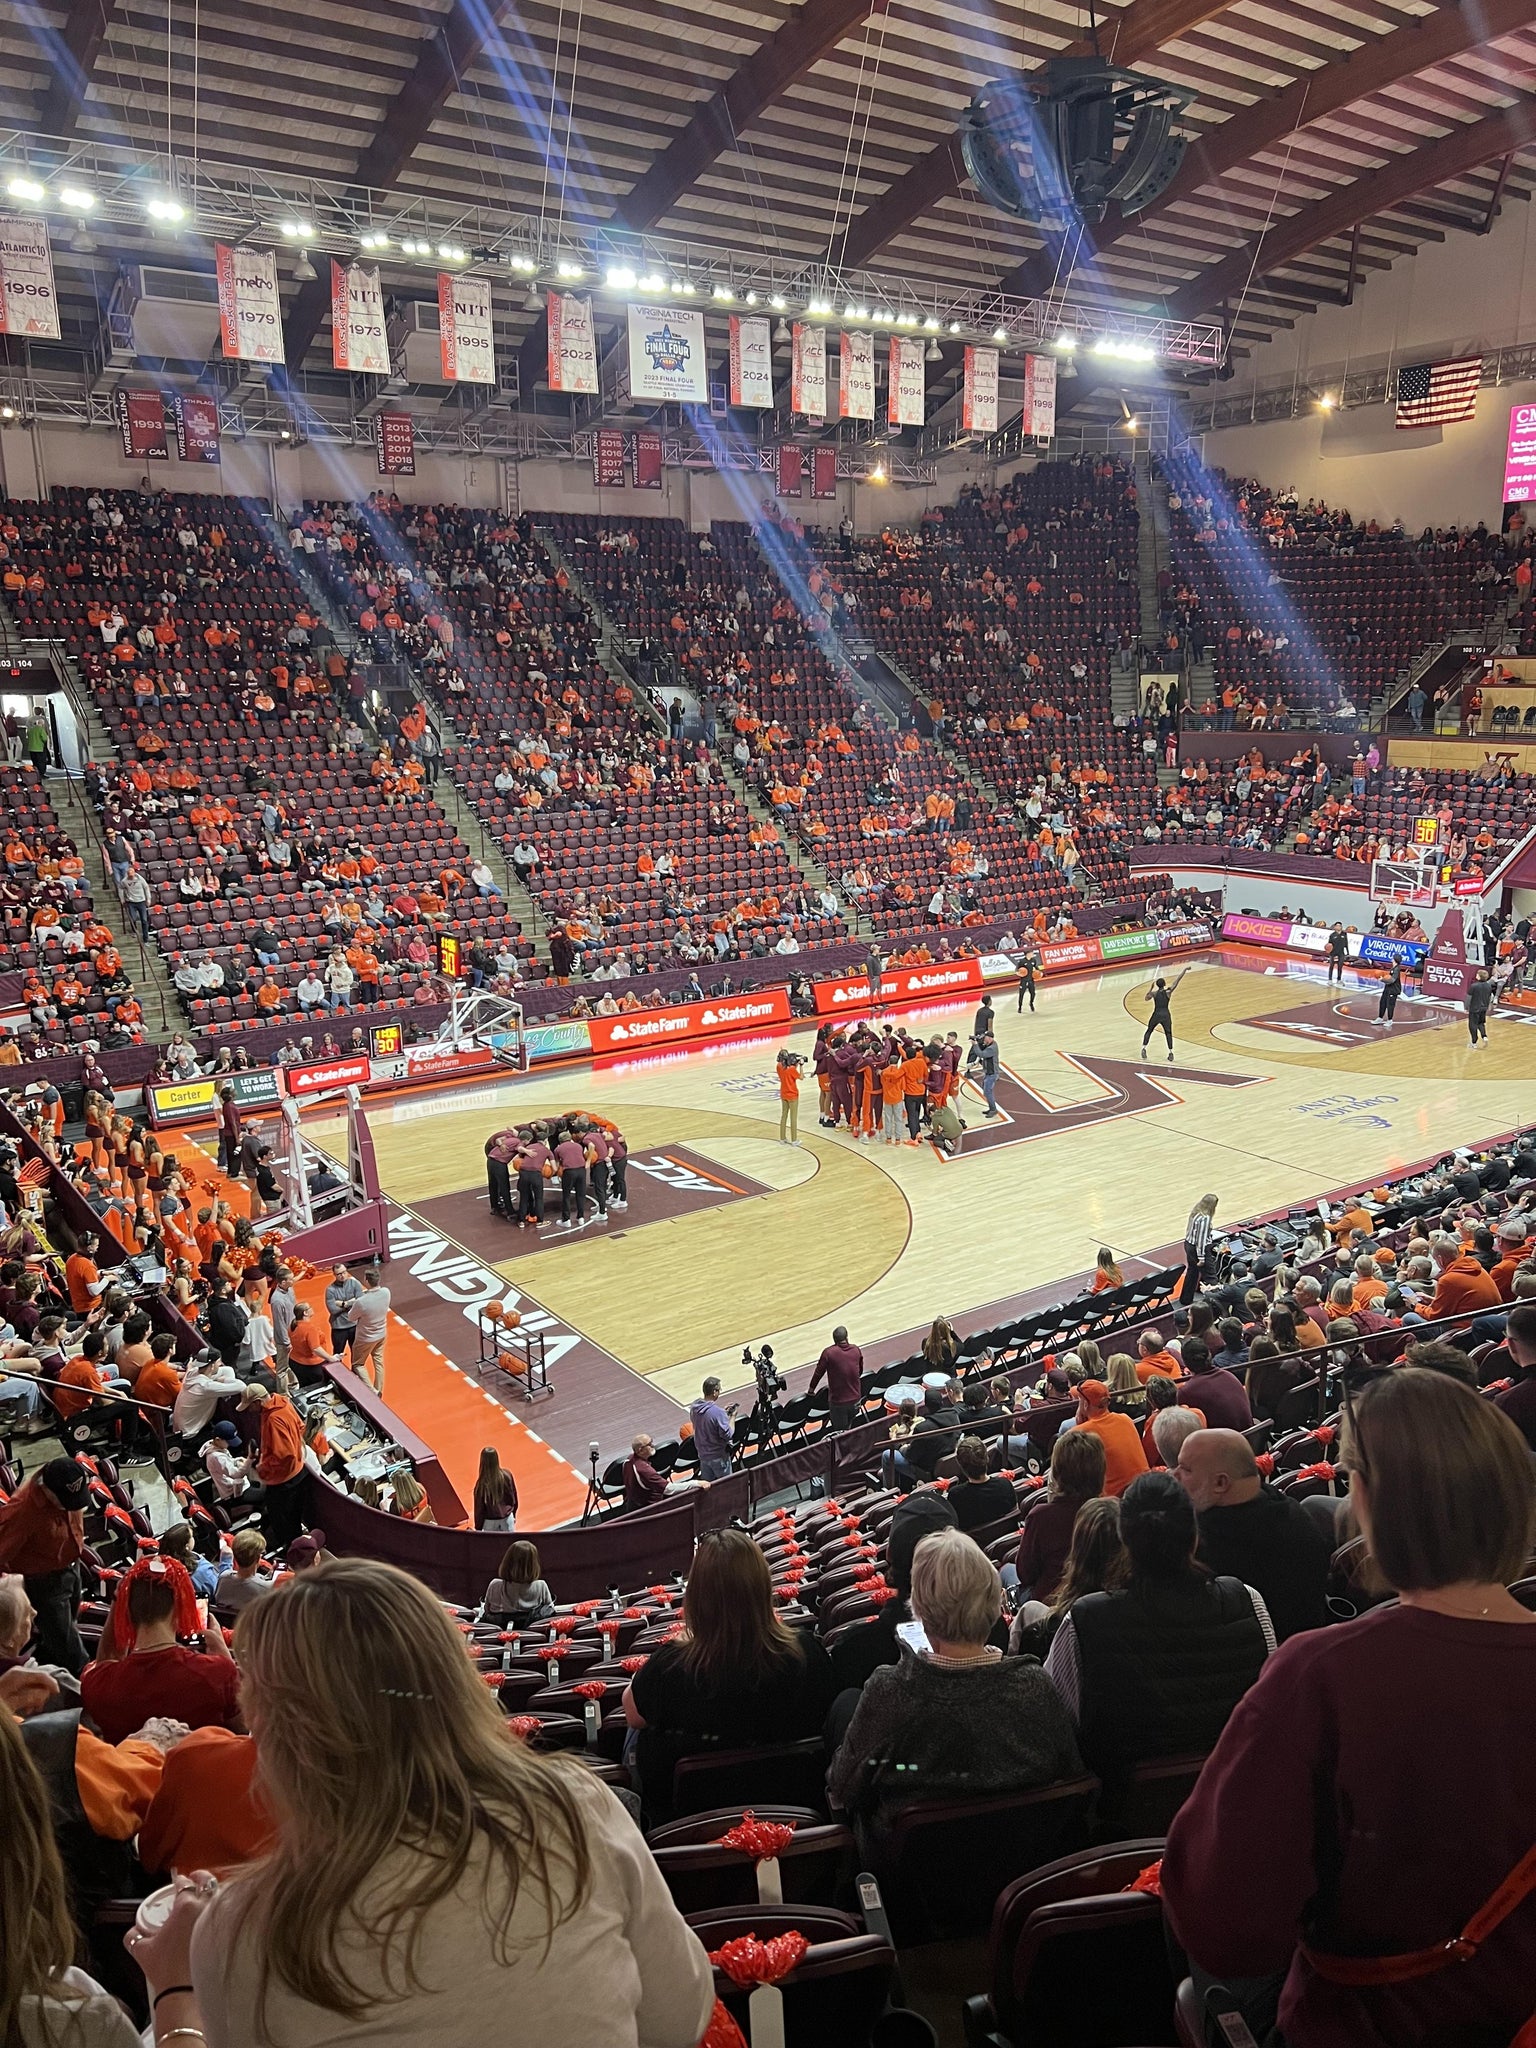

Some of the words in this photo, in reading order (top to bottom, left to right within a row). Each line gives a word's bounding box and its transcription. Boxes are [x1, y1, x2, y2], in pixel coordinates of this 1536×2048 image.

[0, 218, 44, 228] HAMPIONS
[235, 275, 273, 291] metro
[4, 281, 50, 298] 1996
[223, 253, 237, 347] BASKETBALL
[350, 288, 379, 304] NIT
[338, 271, 348, 359] BASKETBALL
[455, 303, 488, 317] NIT
[636, 306, 672, 319] VIRGINIA
[673, 311, 694, 321] TECH
[238, 311, 275, 325] 1979
[564, 318, 587, 329] ACC
[348, 324, 382, 337] 1973
[444, 283, 454, 370] BASKETBALL
[456, 336, 490, 349] 1995
[746, 343, 765, 352] ACC
[560, 349, 593, 361] 2022
[645, 341, 668, 354] FINAL
[668, 342, 690, 358] FOUR
[805, 347, 823, 356] ACC
[743, 370, 769, 381] 2024
[801, 374, 825, 386] 2023
[848, 380, 872, 391] 1995
[899, 386, 922, 396] 1994
[973, 394, 996, 404] 1999
[1033, 399, 1053, 409] 1998
[118, 392, 132, 454] WRESTLING
[133, 420, 162, 430] 1993
[175, 396, 186, 457] WRESTLING
[386, 423, 411, 432] 2013
[189, 439, 217, 448] 2016
[376, 414, 386, 470] WRESTLING
[386, 434, 411, 442] 2014
[600, 439, 622, 447] 2015
[388, 445, 411, 453] 2017
[638, 442, 660, 450] 2023
[782, 445, 801, 453] 1992
[816, 448, 835, 456] 2010
[592, 431, 600, 483] WRESTLING
[601, 449, 623, 457] 2016
[388, 455, 413, 464] 2018
[601, 459, 623, 467] 2017
[602, 469, 623, 477] 2021
[0, 659, 11, 667] 03
[17, 659, 32, 667] 104
[1417, 828, 1435, 844] 30
[1228, 918, 1284, 939] HOKIES
[1103, 935, 1145, 949] DAVENPORT
[1367, 939, 1408, 954] VIRGINIA
[1044, 949, 1060, 959] FAN
[1062, 945, 1086, 955] WORK
[1364, 948, 1388, 959] Credit
[442, 950, 456, 976] 30
[1426, 965, 1464, 979] DELTA
[1428, 974, 1462, 986] STAR
[63, 989, 78, 999] 25
[541, 1024, 585, 1048] County
[1264, 1020, 1375, 1042] ACC
[378, 1038, 395, 1054] 30
[240, 1077, 258, 1087] LET'S
[259, 1075, 273, 1084] GET
[241, 1086, 252, 1094] TO
[170, 1090, 201, 1103] Carter
[1313, 1095, 1400, 1120] CARILION
[76, 1429, 87, 1437] VT
[66, 1476, 84, 1493] VT
